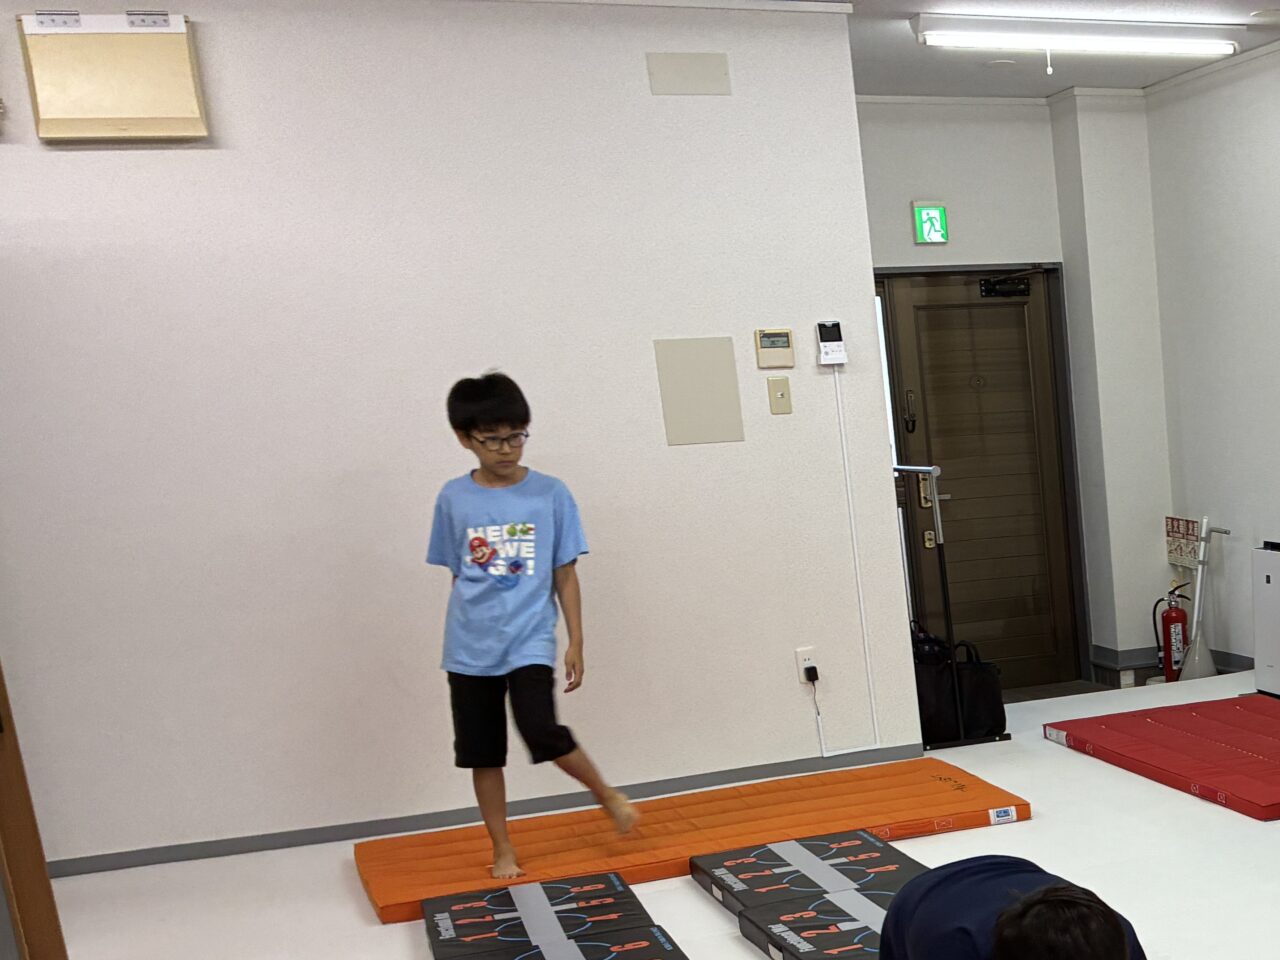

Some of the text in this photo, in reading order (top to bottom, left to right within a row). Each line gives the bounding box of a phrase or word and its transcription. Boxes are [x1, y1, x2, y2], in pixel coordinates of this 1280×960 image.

[496, 541, 535, 558] WE
[829, 840, 899, 873] 4 5 6
[724, 857, 790, 893] 1 2 3
[610, 940, 650, 952] 6
[780, 911, 863, 954] 1 2 3
